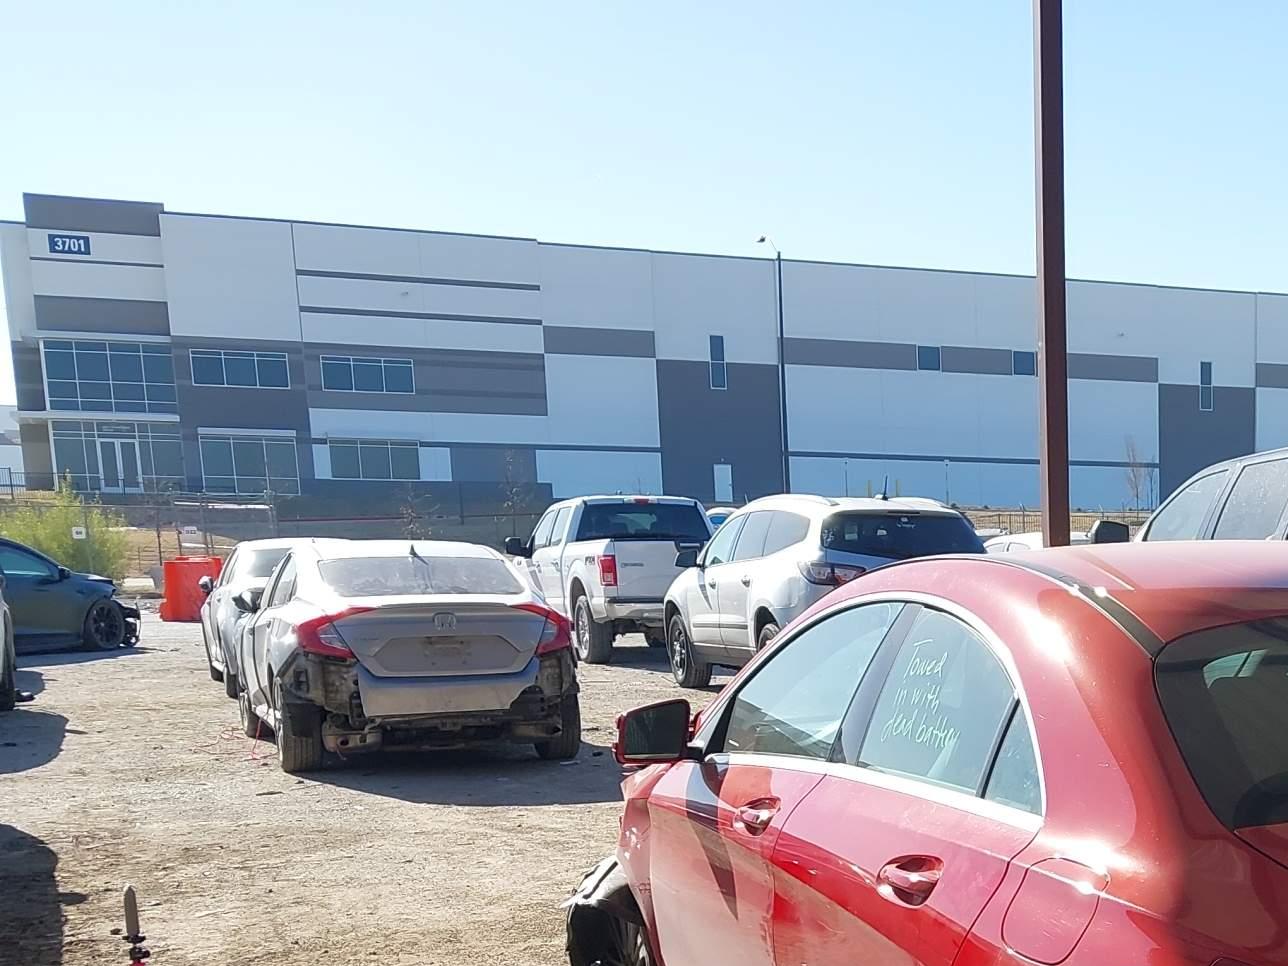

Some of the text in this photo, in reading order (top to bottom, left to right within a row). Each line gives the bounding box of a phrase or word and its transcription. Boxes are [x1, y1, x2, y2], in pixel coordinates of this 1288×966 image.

[54, 237, 85, 252] 3701
[903, 639, 948, 683] Towed
[910, 681, 940, 715] with
[880, 708, 919, 742] dead
